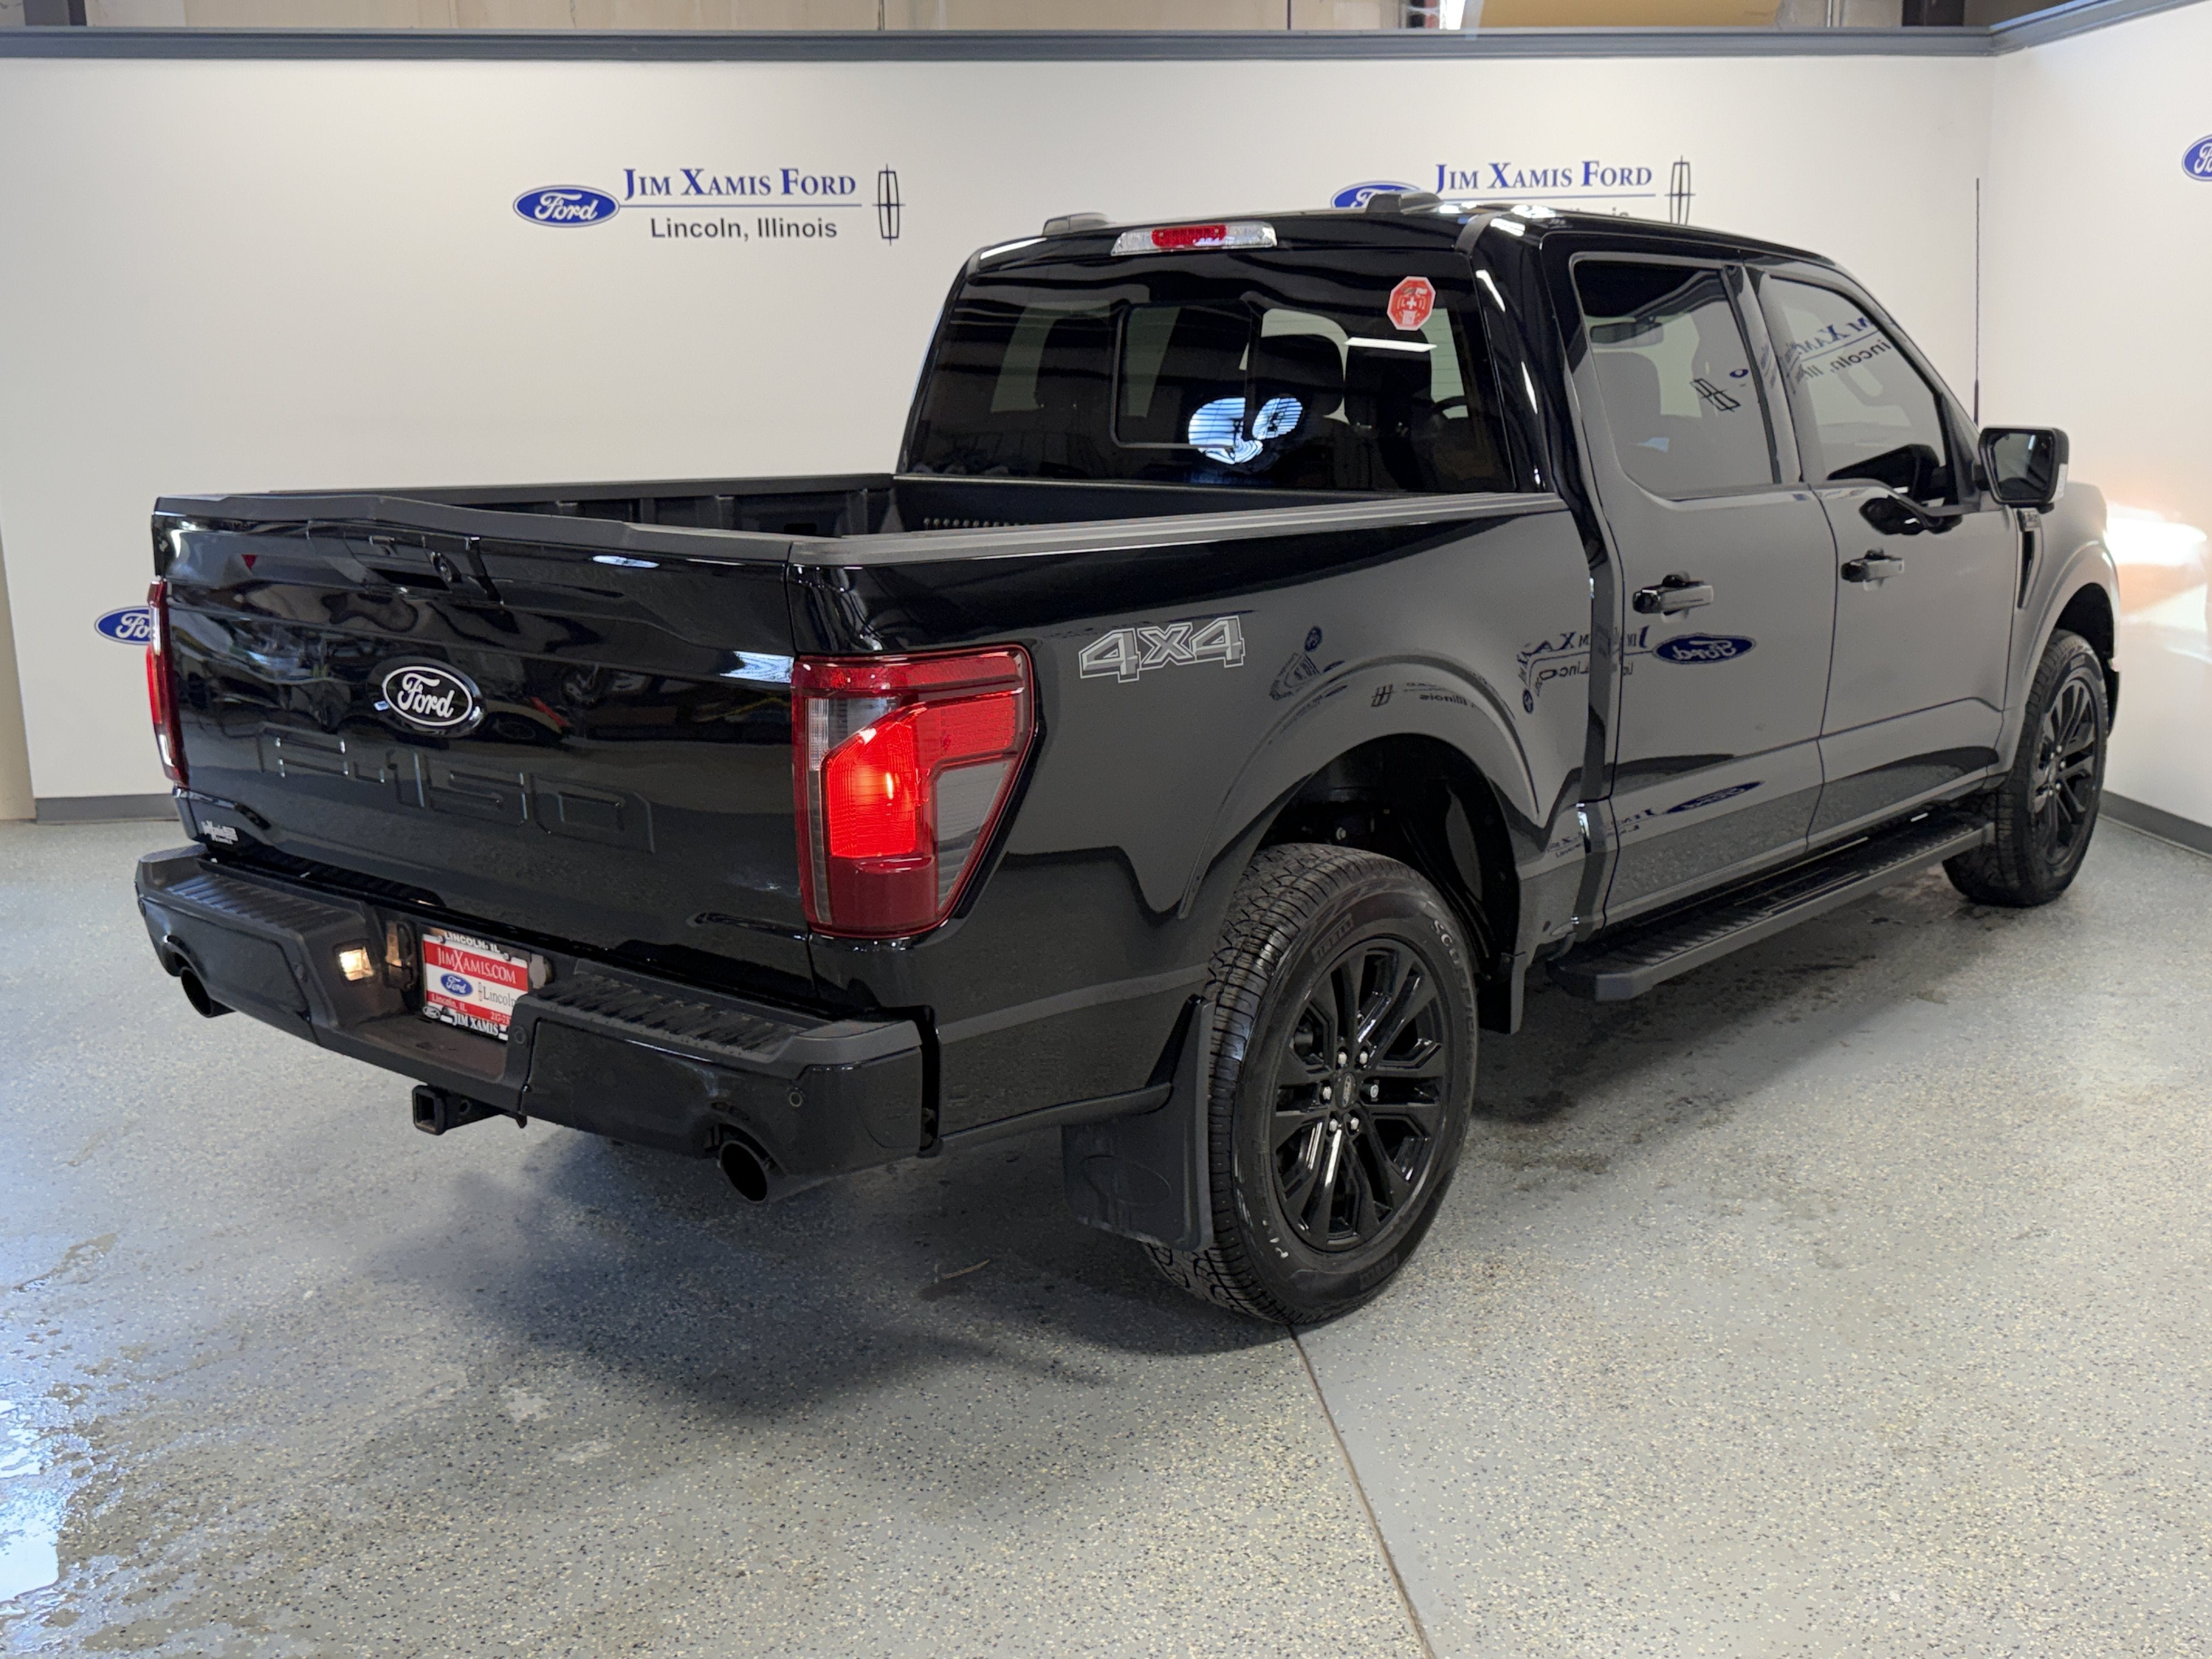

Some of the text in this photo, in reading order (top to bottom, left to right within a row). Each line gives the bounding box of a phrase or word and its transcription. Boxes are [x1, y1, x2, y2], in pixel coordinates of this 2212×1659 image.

[534, 192, 598, 221] Ford
[651, 218, 838, 241] Lincoln, Illinois
[397, 672, 455, 718] Ford
[445, 975, 467, 994] Ford
